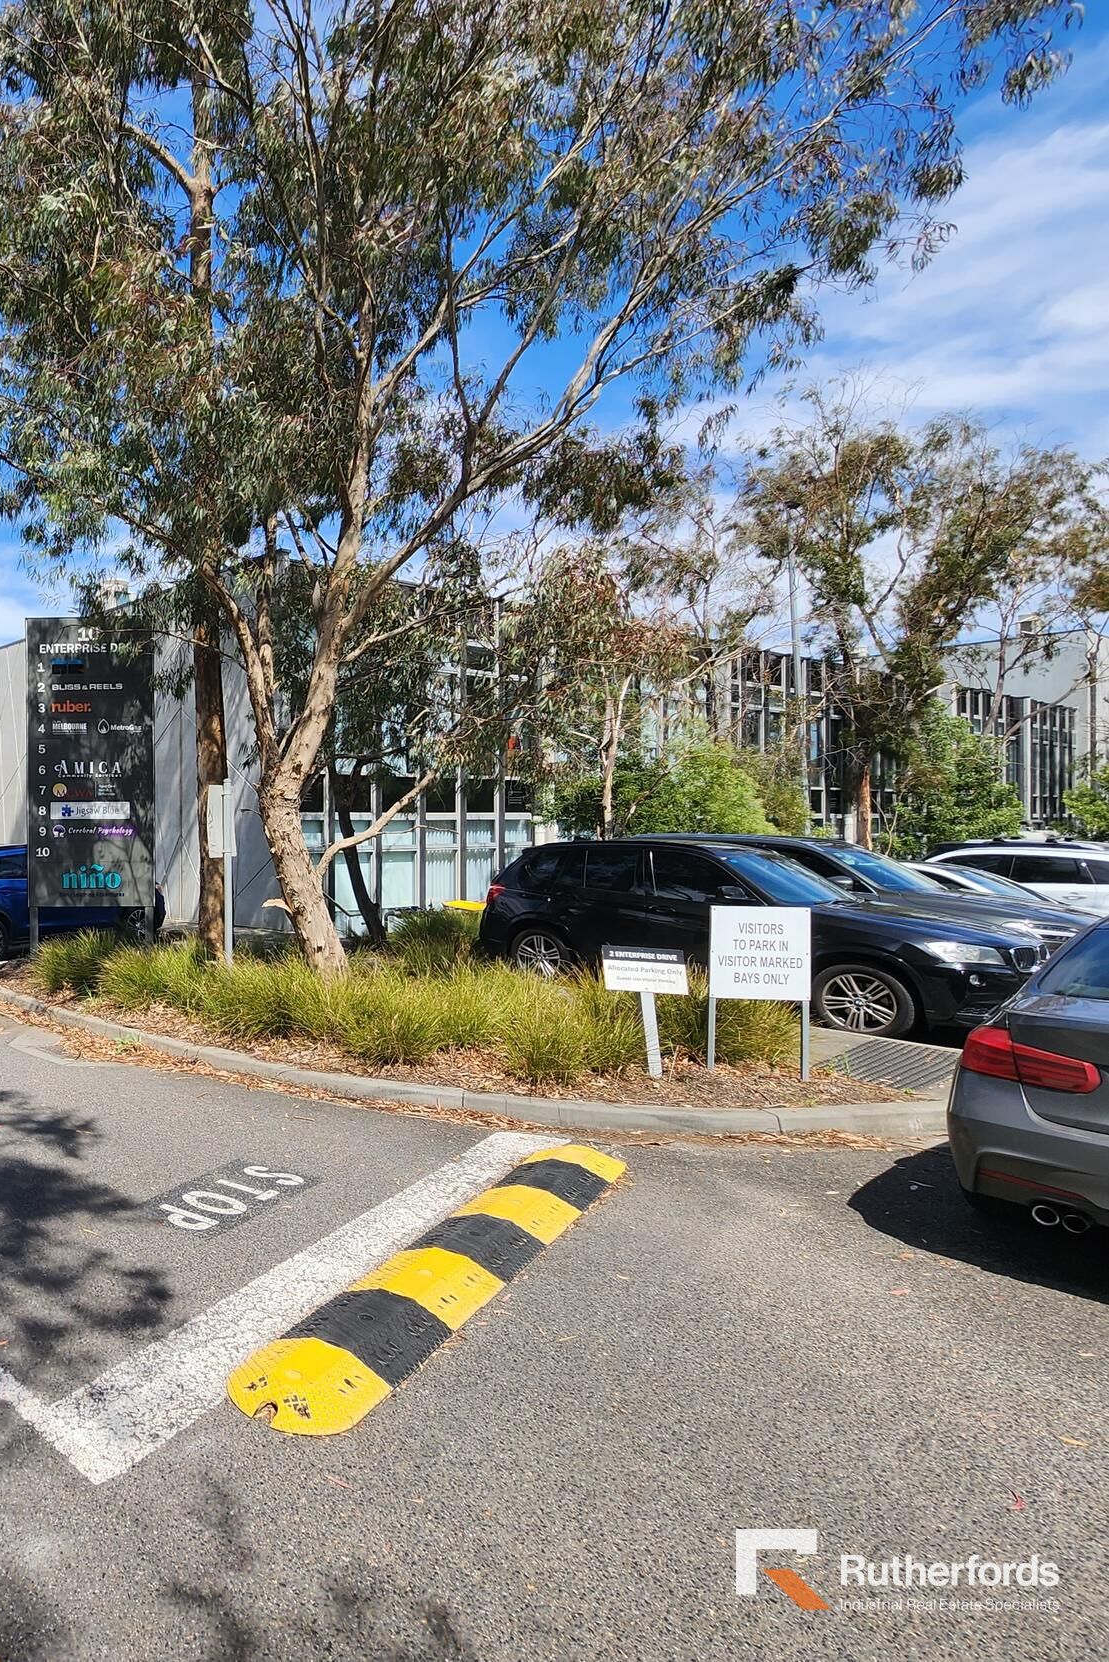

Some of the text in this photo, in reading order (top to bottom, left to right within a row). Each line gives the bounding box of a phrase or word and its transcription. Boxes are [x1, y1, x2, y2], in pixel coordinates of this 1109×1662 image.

[77, 626, 100, 642] 10
[39, 643, 108, 654] ENTERPRISE
[37, 662, 45, 672] 1
[37, 682, 46, 692] 2
[38, 700, 92, 713] 3 ruber.
[38, 724, 46, 734] 4
[38, 744, 46, 754] 5
[38, 760, 122, 774] 6 AMICA
[39, 786, 46, 796] 7
[38, 806, 120, 816] 8 Jigsaw Blue
[39, 826, 134, 836] 9 Cerebral Psychology
[36, 848, 50, 857] 10
[62, 864, 122, 889] niño
[738, 922, 784, 935] VISITORS
[733, 939, 788, 952] TO PARK IN
[615, 951, 655, 960] ENTERPRISE
[718, 955, 803, 968] VISITOR MARKED
[608, 964, 682, 976] Allocated Parking Only
[734, 972, 790, 985] BAYS ONLY
[159, 1165, 305, 1231] STOP
